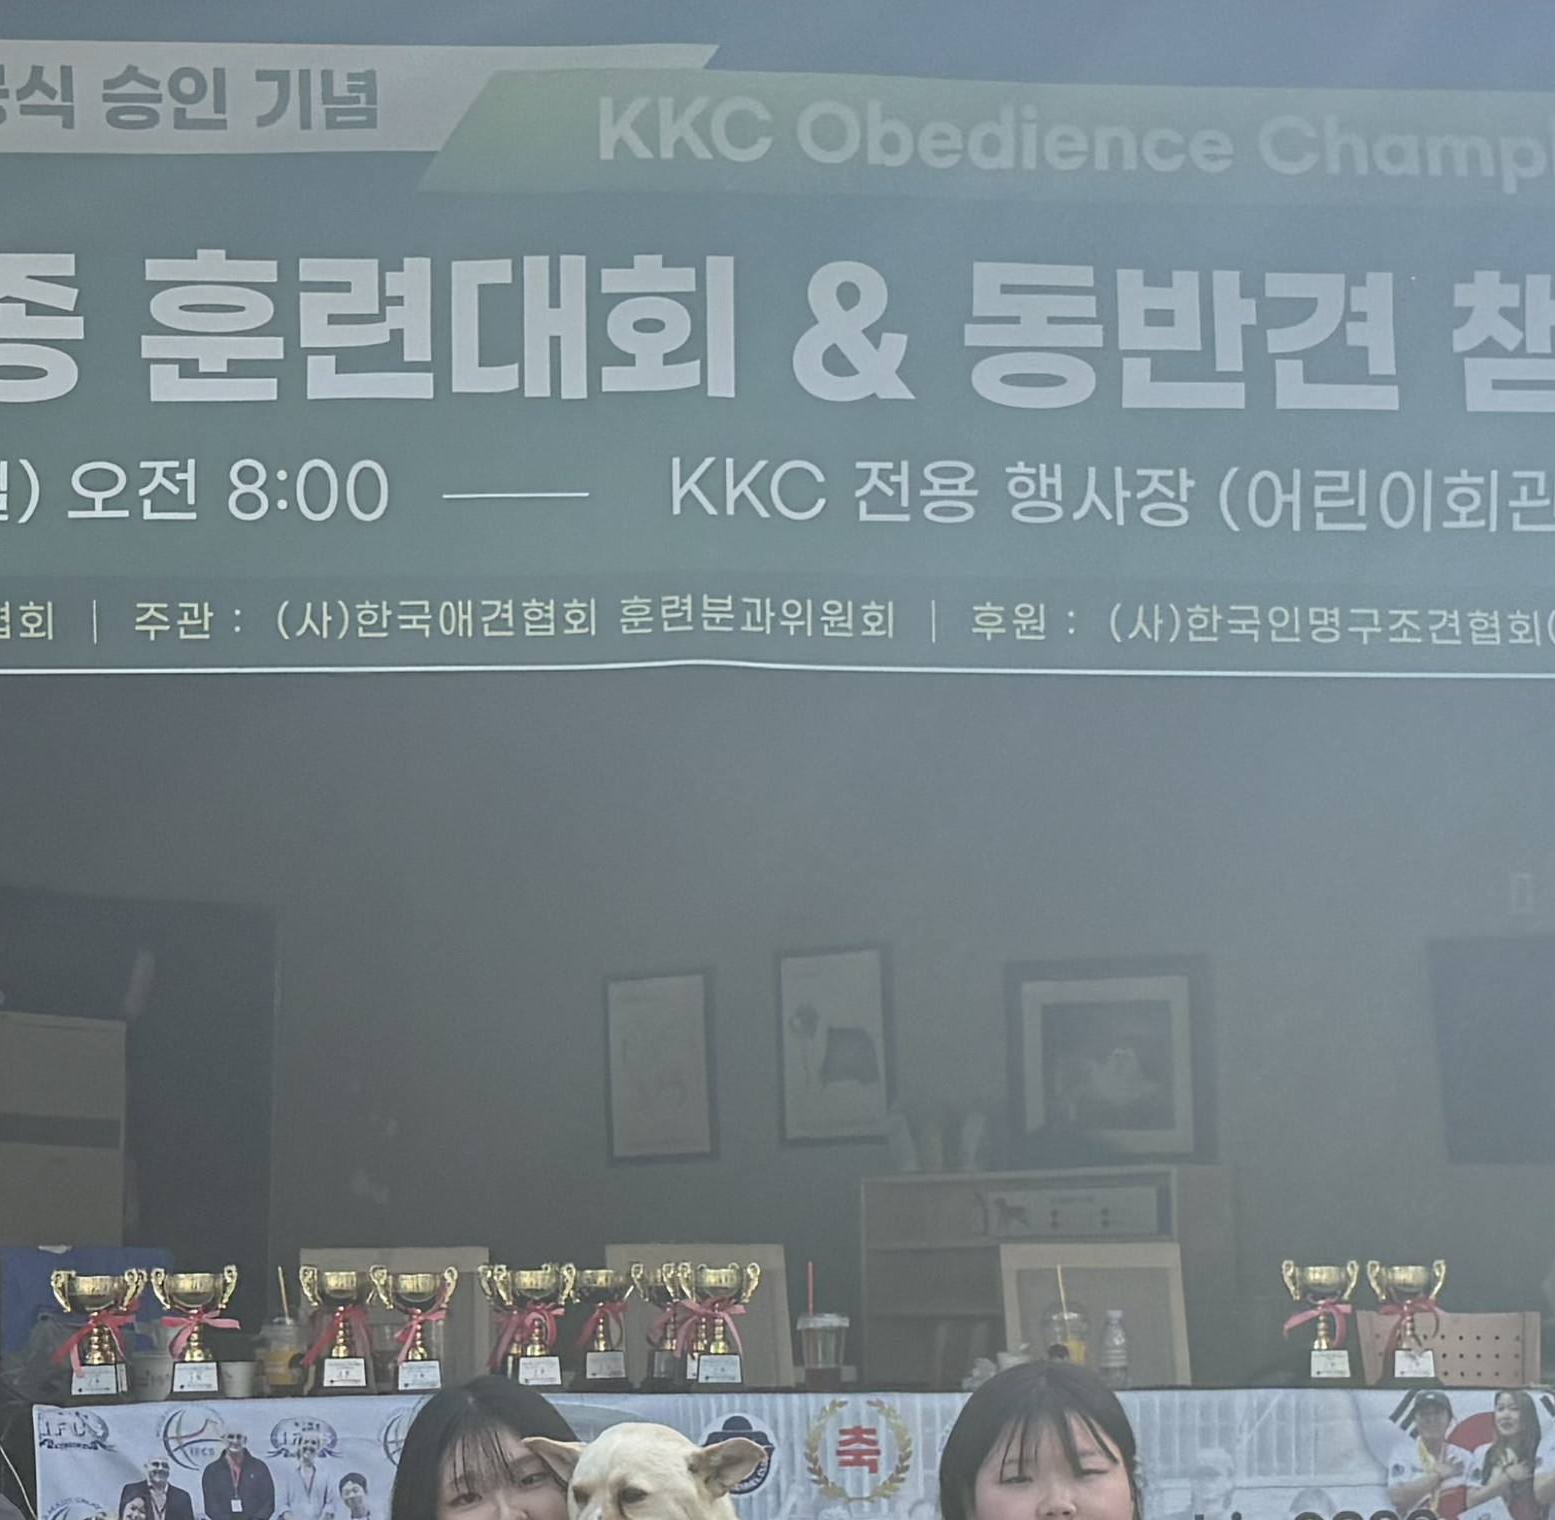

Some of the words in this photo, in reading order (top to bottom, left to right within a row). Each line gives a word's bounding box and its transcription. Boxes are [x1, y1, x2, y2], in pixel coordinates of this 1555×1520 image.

[101, 65, 229, 131] 승인
[253, 66, 379, 131] 기념
[597, 95, 774, 164] KKC
[796, 99, 1235, 174] Obedience
[140, 249, 736, 403] 훈련대회
[791, 260, 917, 403] &
[963, 261, 1400, 410] 동반견
[66, 459, 198, 523] 오전
[226, 457, 390, 523] 8:00
[669, 455, 828, 522] KKC
[852, 458, 980, 525] 전용
[1005, 459, 1194, 530] 행사장
[132, 600, 214, 642] 주관
[618, 593, 896, 642] 훈련분과위원회
[970, 600, 1047, 643] 후원
[835, 1424, 882, 1474] 축
